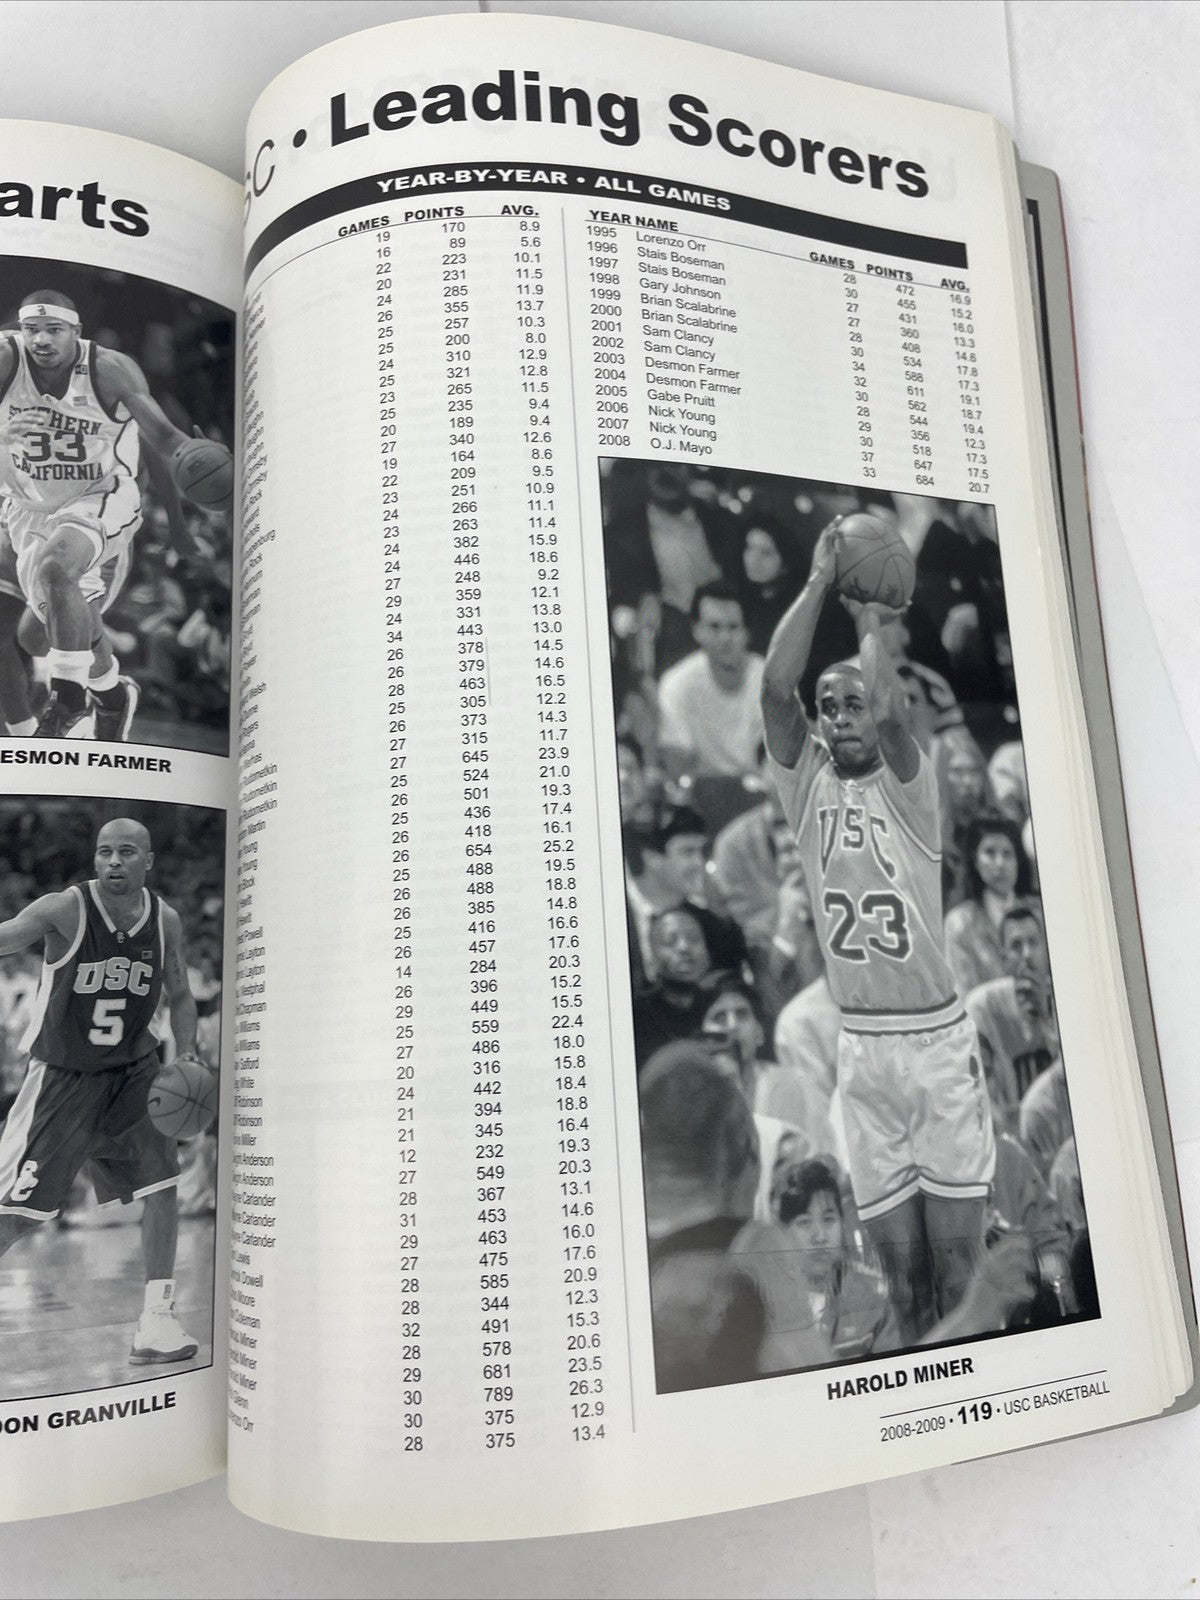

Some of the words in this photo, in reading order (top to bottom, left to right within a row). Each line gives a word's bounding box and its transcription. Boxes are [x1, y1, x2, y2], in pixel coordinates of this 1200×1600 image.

[331, 70, 640, 146] Leading
[668, 93, 929, 198] Scorers
[377, 169, 568, 193] YEAR-BY-YEAR
[594, 175, 641, 194] ALL
[648, 182, 731, 211] GAMES
[0, 181, 150, 237] arts
[338, 214, 390, 238] GAMES
[404, 206, 464, 222] POINTS
[501, 204, 538, 216] AVG.
[376, 231, 390, 242] 19
[442, 222, 465, 233] 170
[520, 221, 540, 231] 8.9
[587, 225, 617, 238] 1995
[636, 231, 684, 248] Lorenzo
[687, 240, 706, 251] Orr
[587, 241, 618, 253] 1996
[637, 247, 667, 260] Stais
[670, 251, 724, 270] Boseman
[590, 210, 632, 225] YEAR
[635, 216, 679, 232] NAME
[810, 250, 856, 270] GAMES
[866, 262, 914, 282] POINTS
[940, 277, 970, 293] AVG.
[588, 257, 618, 268] 1997
[638, 262, 668, 276] Stais
[672, 267, 726, 285] Boseman
[377, 294, 392, 306] 24
[443, 285, 468, 297] 285
[517, 284, 543, 295] 11.9
[590, 288, 621, 300] 1999
[640, 293, 672, 307] Brian
[675, 298, 736, 318] Scalabrine
[589, 272, 620, 285] 1998
[639, 278, 669, 293] Gary
[672, 283, 721, 300] Johnson
[848, 317, 860, 327] 27
[901, 327, 919, 339] 360
[954, 337, 975, 348] 13.3
[591, 320, 621, 332] 2001
[643, 325, 671, 338] Sam
[674, 329, 714, 346] Clancy
[591, 304, 622, 316] 2000
[642, 309, 673, 322] Brian
[677, 314, 737, 333] Scalabrine
[851, 346, 864, 357] 30
[904, 356, 922, 367] 534
[957, 366, 978, 377] 17.8
[379, 359, 394, 371] 24
[446, 350, 471, 362] 310
[519, 349, 547, 360] 12.9
[592, 336, 624, 348] 2002
[644, 341, 672, 354] Sam
[675, 345, 715, 362] Clancy
[854, 376, 867, 387] 32
[907, 386, 924, 397] 611
[960, 395, 979, 405] 19.1
[594, 352, 625, 364] 2003
[645, 357, 695, 372] Desmon
[699, 364, 740, 379] Farmer
[594, 368, 626, 380] 2004
[646, 373, 696, 388] Desmon
[700, 379, 741, 395] Farmer
[857, 406, 870, 417] 28
[910, 415, 928, 426] 544
[963, 424, 983, 434] 19.4
[596, 384, 627, 397] 2005
[647, 389, 681, 402] Gabe
[684, 393, 715, 407] Pruitt
[381, 425, 396, 437] 20
[450, 417, 473, 428] 189
[530, 415, 550, 426] 9.4
[596, 401, 628, 413] 2006
[649, 405, 675, 418] Nick
[678, 408, 716, 425] Young
[860, 436, 873, 447] 30
[913, 444, 932, 456] 518
[967, 453, 987, 464] 17.3
[598, 417, 629, 429] 2007
[650, 421, 677, 434] Nick
[679, 424, 717, 441] Young
[22, 430, 86, 462] 33
[12, 454, 104, 480] CALIFORNIA
[599, 434, 630, 446] 2008
[650, 438, 676, 450] O.J.
[680, 441, 712, 456] Mayo
[863, 467, 876, 477] 33
[916, 474, 934, 485] 684
[969, 482, 989, 493] 20.7
[383, 492, 398, 504] 23
[452, 484, 475, 496] 251
[526, 482, 554, 493] 10.9
[385, 561, 400, 573] 24
[454, 553, 480, 565] 446
[529, 551, 558, 563] 18.6
[387, 631, 403, 643] 34
[457, 624, 483, 636] 443
[533, 621, 562, 633] 13.0
[389, 702, 405, 715] 25
[460, 695, 486, 708] 305
[537, 693, 566, 704] 12.2
[1, 750, 80, 766] ESMON
[88, 753, 172, 774] FARMER
[391, 775, 408, 788] 25
[463, 769, 489, 781] 524
[540, 765, 570, 778] 21.0
[392, 850, 410, 863] 26
[466, 843, 492, 857] 654
[543, 840, 574, 852] 25.2
[817, 805, 898, 881] USC
[394, 926, 411, 939] 25
[468, 920, 495, 934] 416
[548, 916, 578, 929] 16.6
[824, 888, 913, 963] 23
[72, 956, 154, 996] USC
[396, 1005, 413, 1019] 29
[470, 999, 498, 1013] 449
[552, 994, 583, 1008] 15.5
[88, 998, 127, 1046] 5
[397, 1087, 415, 1100] 24
[473, 1081, 501, 1095] 442
[556, 1075, 587, 1090] 18.4
[399, 1170, 417, 1184] 27
[477, 1165, 505, 1180] 549
[559, 1159, 591, 1174] 20.3
[401, 1256, 418, 1271] 27
[479, 1252, 508, 1267] 475
[564, 1245, 596, 1261] 17.6
[402, 1345, 421, 1359] 28
[483, 1341, 512, 1356] 578
[567, 1333, 600, 1350] 20.6
[827, 1369, 908, 1400] HAROLD
[914, 1357, 974, 1384] MINER
[0, 1415, 38, 1434] ON
[48, 1391, 176, 1429] GRANVILLE
[880, 1415, 946, 1442] 2008-2009
[957, 1400, 993, 1426] 119
[1004, 1396, 1031, 1416] USC
[1034, 1380, 1110, 1410] BASKETBALL
[405, 1436, 423, 1451] 28
[486, 1432, 515, 1448] 375
[573, 1425, 605, 1441] 13.4
